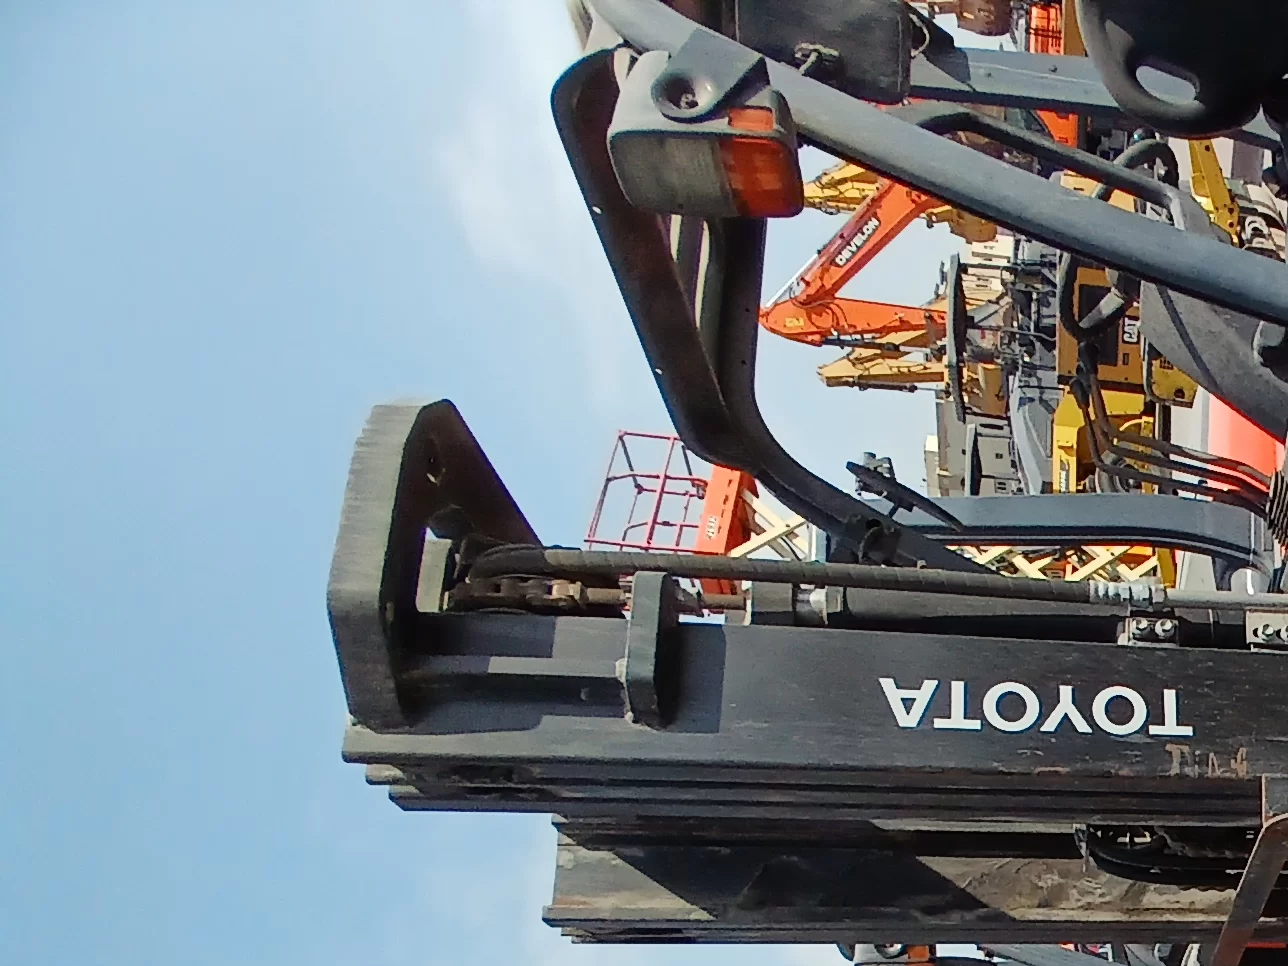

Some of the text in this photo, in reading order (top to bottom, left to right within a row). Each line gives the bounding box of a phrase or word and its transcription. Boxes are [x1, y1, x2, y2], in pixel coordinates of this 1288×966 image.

[834, 217, 880, 266] DEVELON
[1123, 316, 1141, 343] CAT
[878, 676, 1195, 737] TOYOTA
